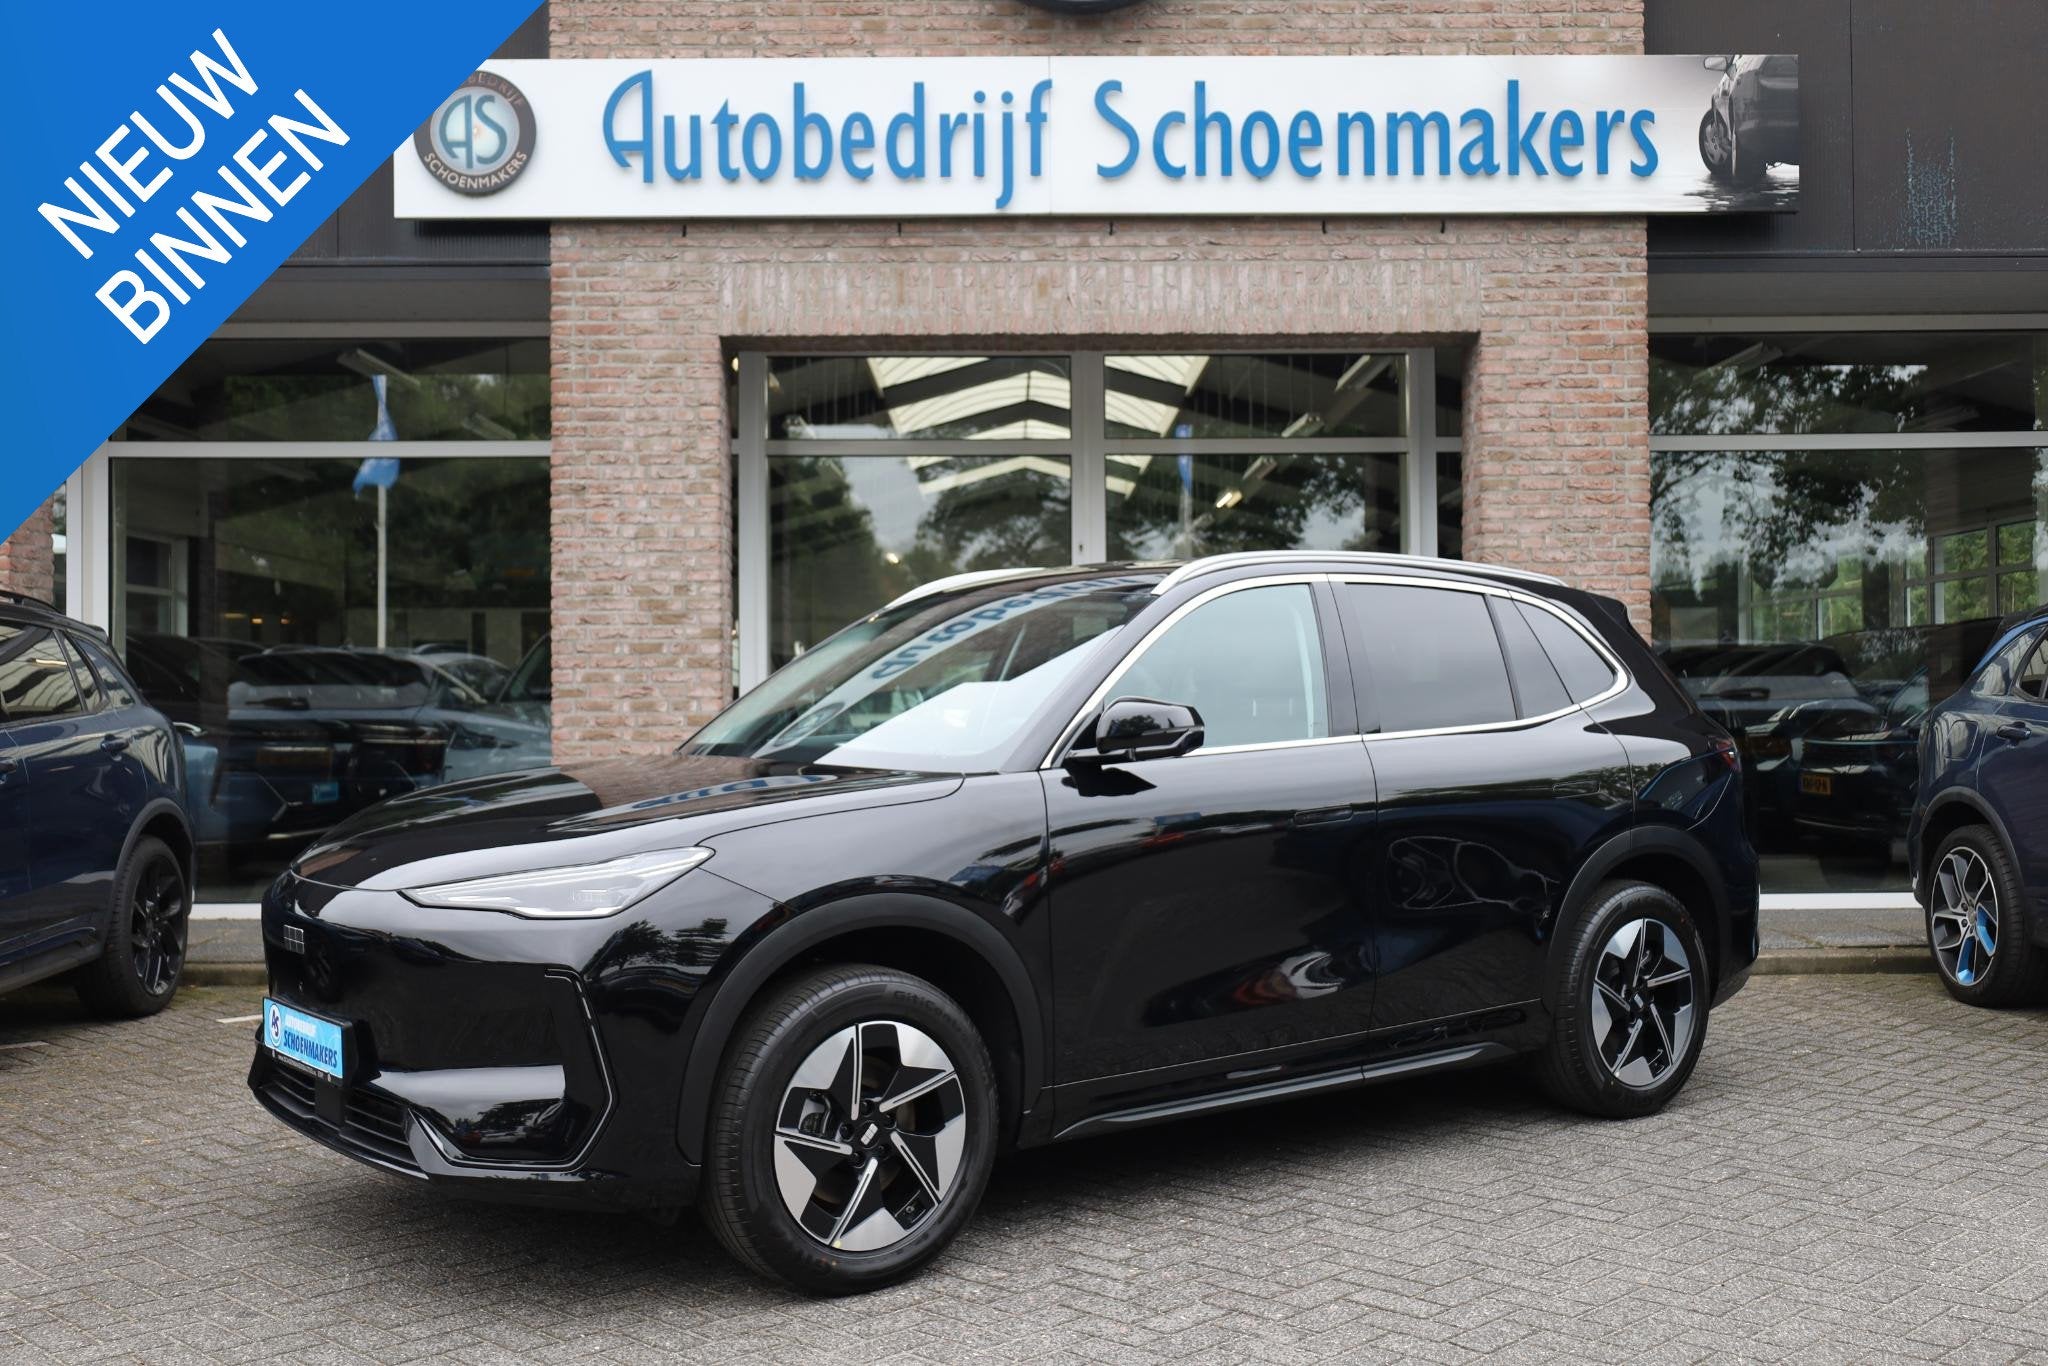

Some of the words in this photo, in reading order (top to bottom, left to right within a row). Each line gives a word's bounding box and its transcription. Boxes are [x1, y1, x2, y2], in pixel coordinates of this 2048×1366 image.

[439, 94, 508, 169] AS
[603, 71, 1053, 209] Autobedrijf
[1094, 79, 1660, 179] Schoenmakers
[424, 151, 528, 190] SCHOENMAKERS
[283, 1030, 338, 1069] SCHOENMAKERS
